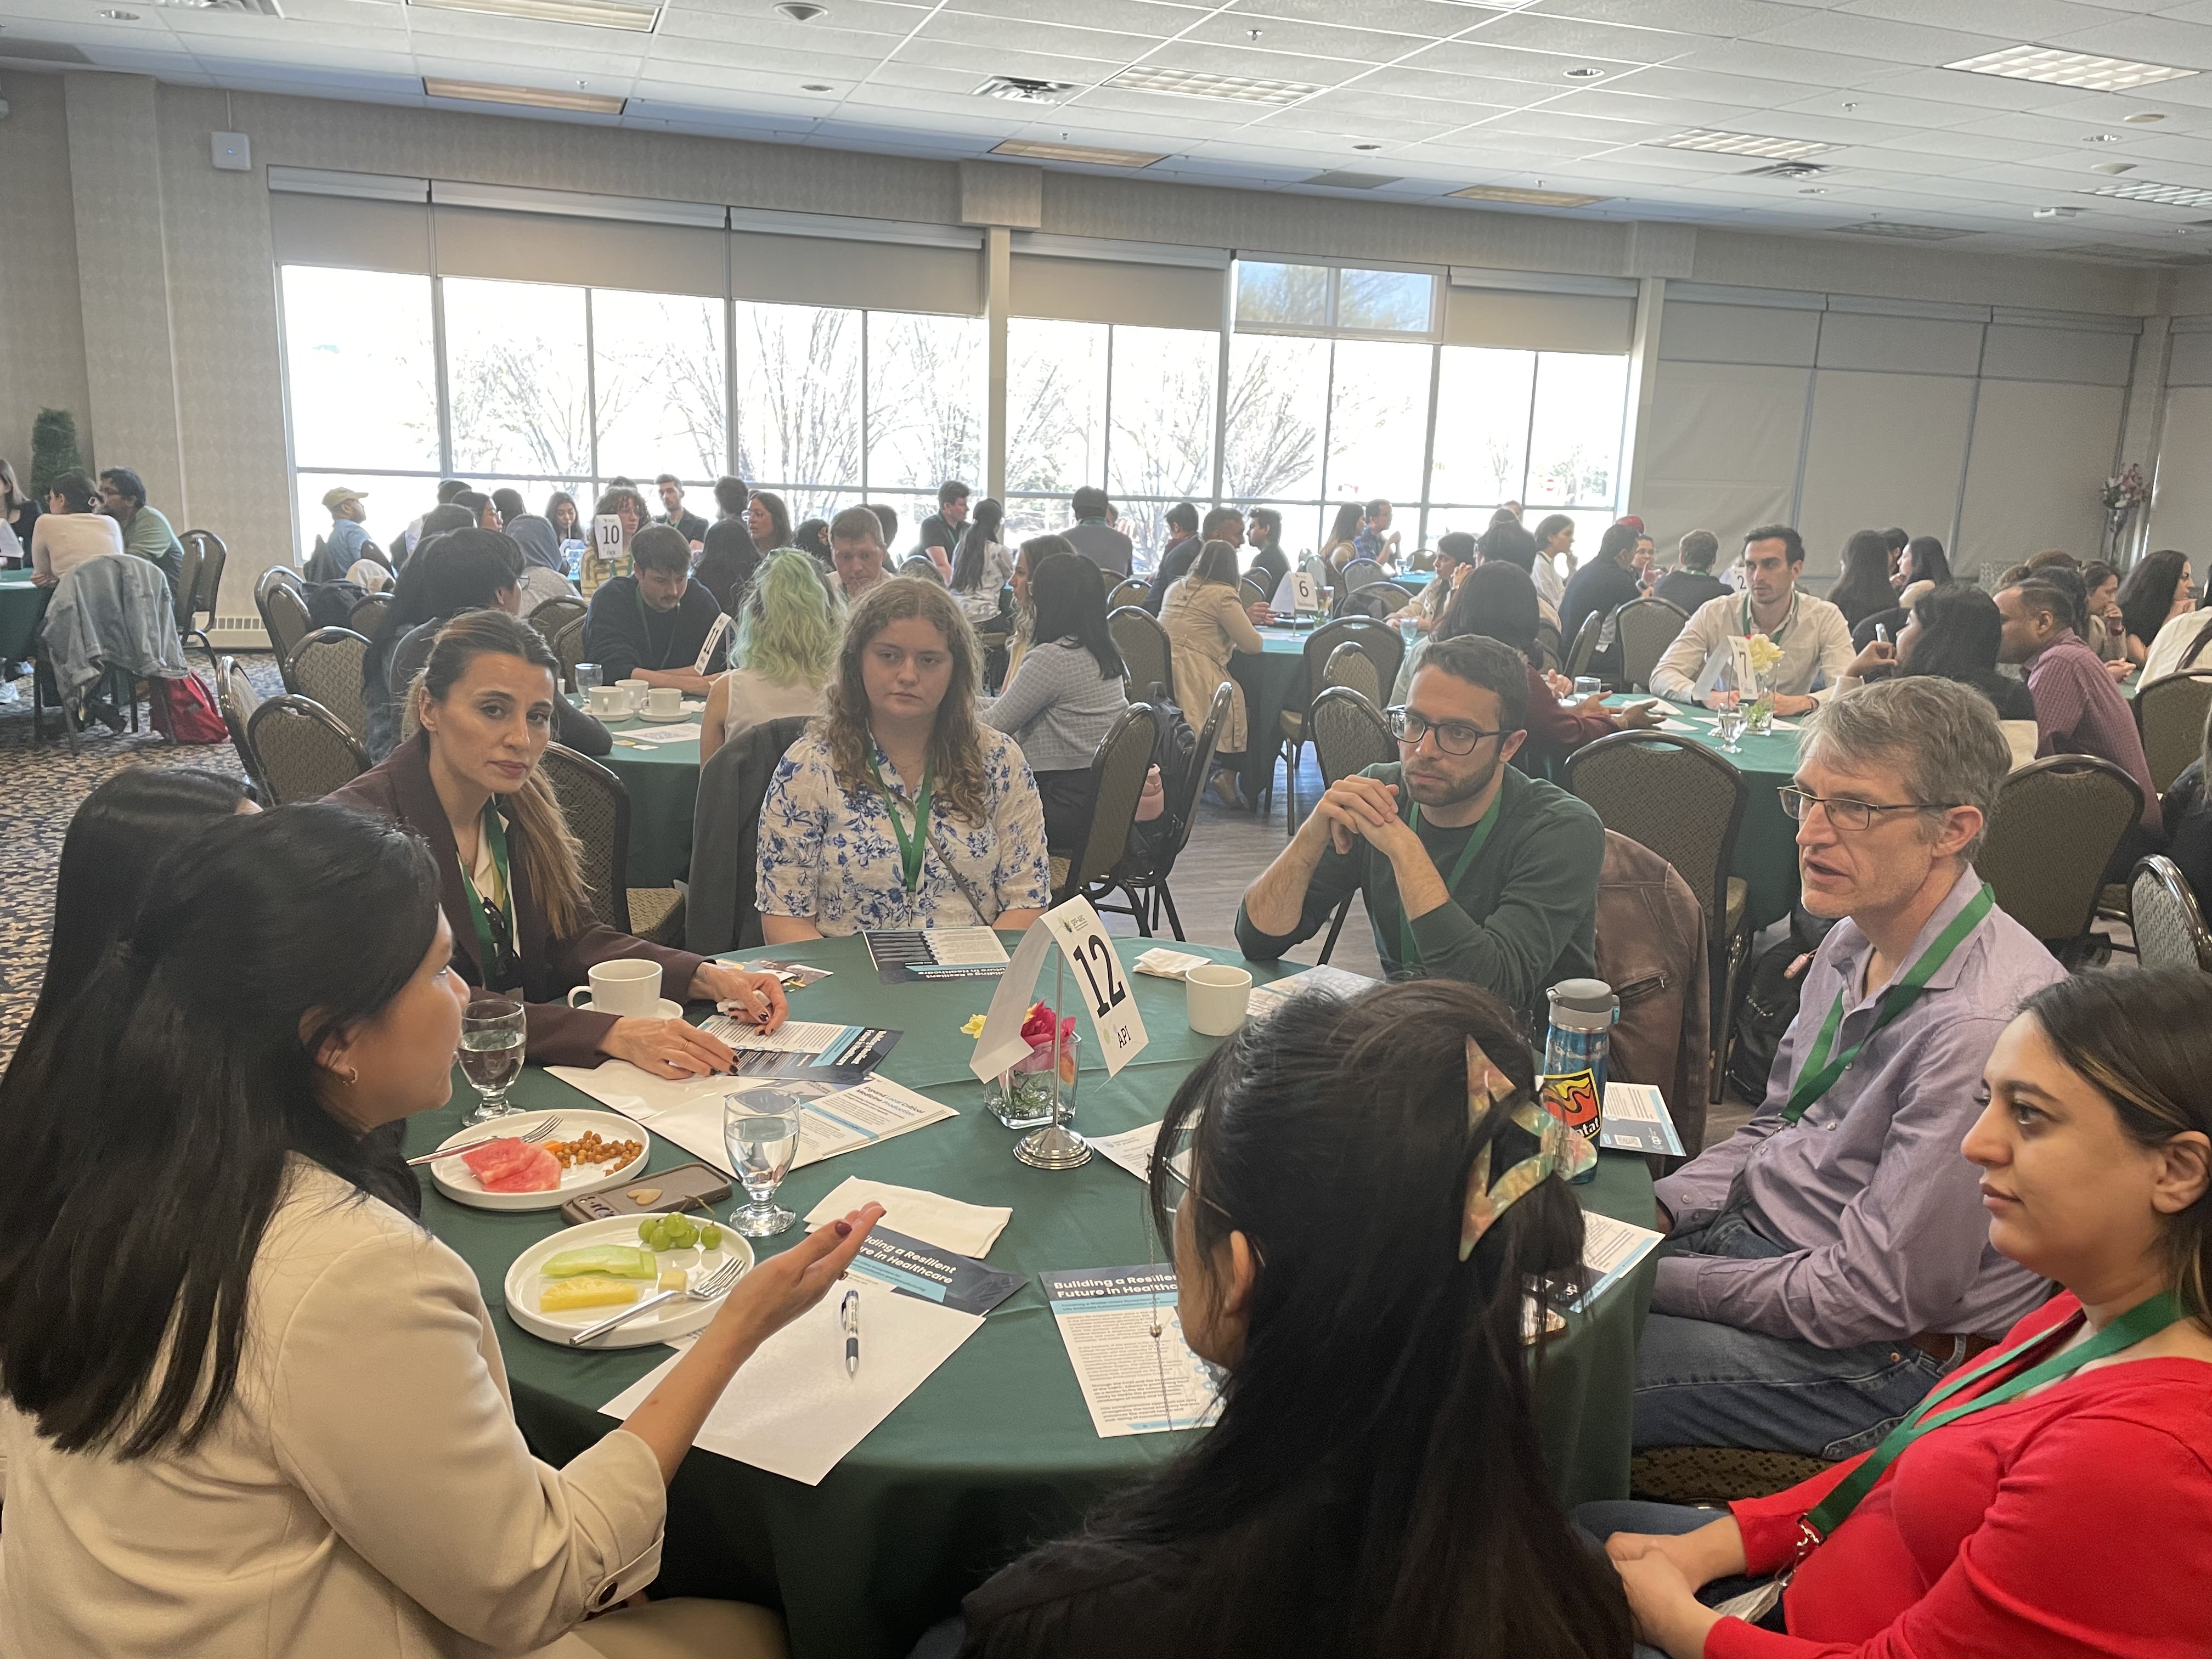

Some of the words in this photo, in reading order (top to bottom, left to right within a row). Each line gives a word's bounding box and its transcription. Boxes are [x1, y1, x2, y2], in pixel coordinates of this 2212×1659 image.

[603, 525, 619, 544] 10
[1299, 580, 1309, 597] 6
[1737, 575, 1747, 590] 2
[703, 628, 720, 656] 11
[1739, 651, 1747, 679] 7
[1073, 934, 1126, 1019] 12
[1117, 1025, 1131, 1048] API
[873, 1251, 887, 1260] in
[886, 1256, 953, 1284] Healthcare
[904, 1250, 957, 1274] Resilient
[1053, 1279, 1114, 1290] Building
[1057, 1289, 1104, 1299] Future
[1106, 1286, 1121, 1295] in
[1122, 1283, 1178, 1294] Healthc
